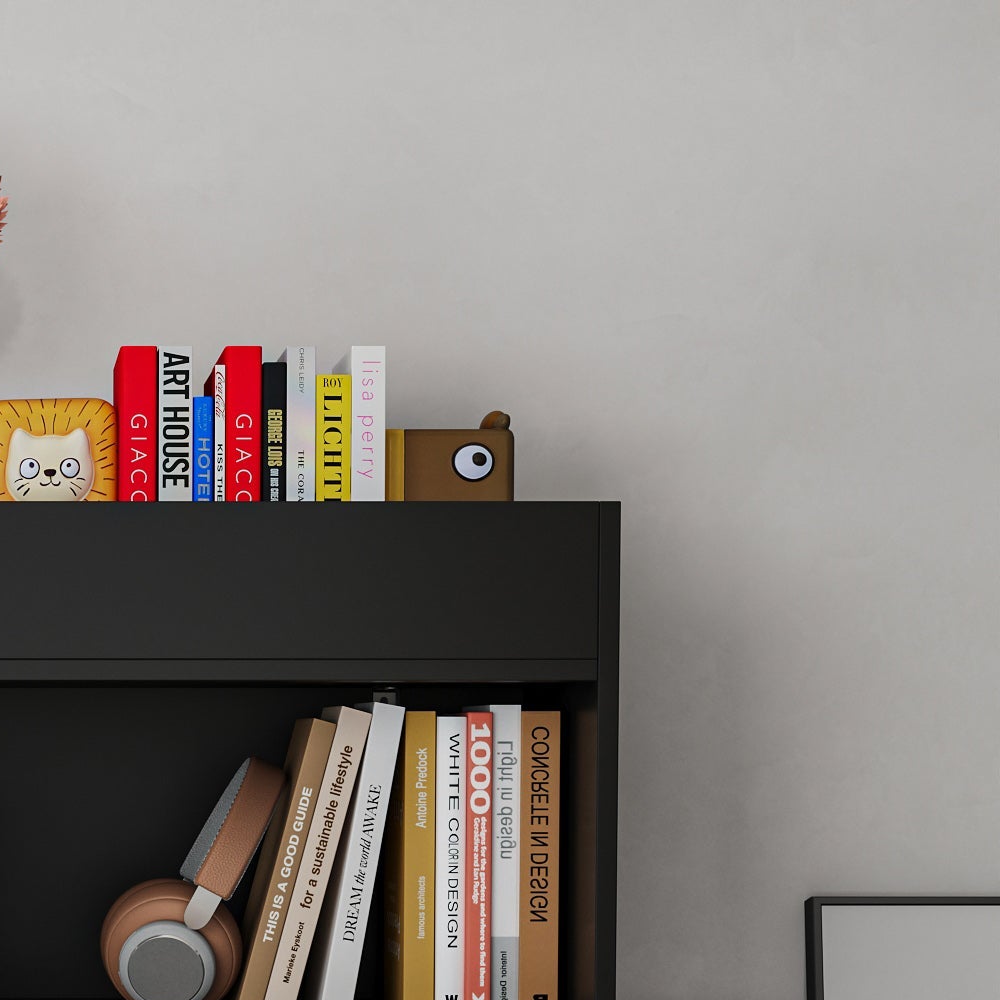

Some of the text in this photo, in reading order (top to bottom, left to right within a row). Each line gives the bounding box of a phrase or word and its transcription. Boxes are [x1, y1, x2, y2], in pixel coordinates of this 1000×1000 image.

[162, 352, 190, 488] ART HOUSE
[323, 378, 343, 388] ROY
[357, 361, 381, 479] lisa perry
[268, 409, 282, 444] GEORGE
[268, 446, 282, 466] LOIS
[416, 748, 428, 829] Antoine Predock
[448, 734, 460, 810] WHITE
[470, 723, 490, 814] 1000
[263, 786, 312, 942] THIS IS A GOOD GUIDE
[300, 745, 353, 909] for a sustainable lifestyle
[342, 784, 382, 942] DREAM the world AWAKE
[292, 921, 305, 951] Eyskoot
[417, 876, 426, 939] famous architects
[448, 878, 458, 948] DESIGN
[480, 942, 487, 950] to
